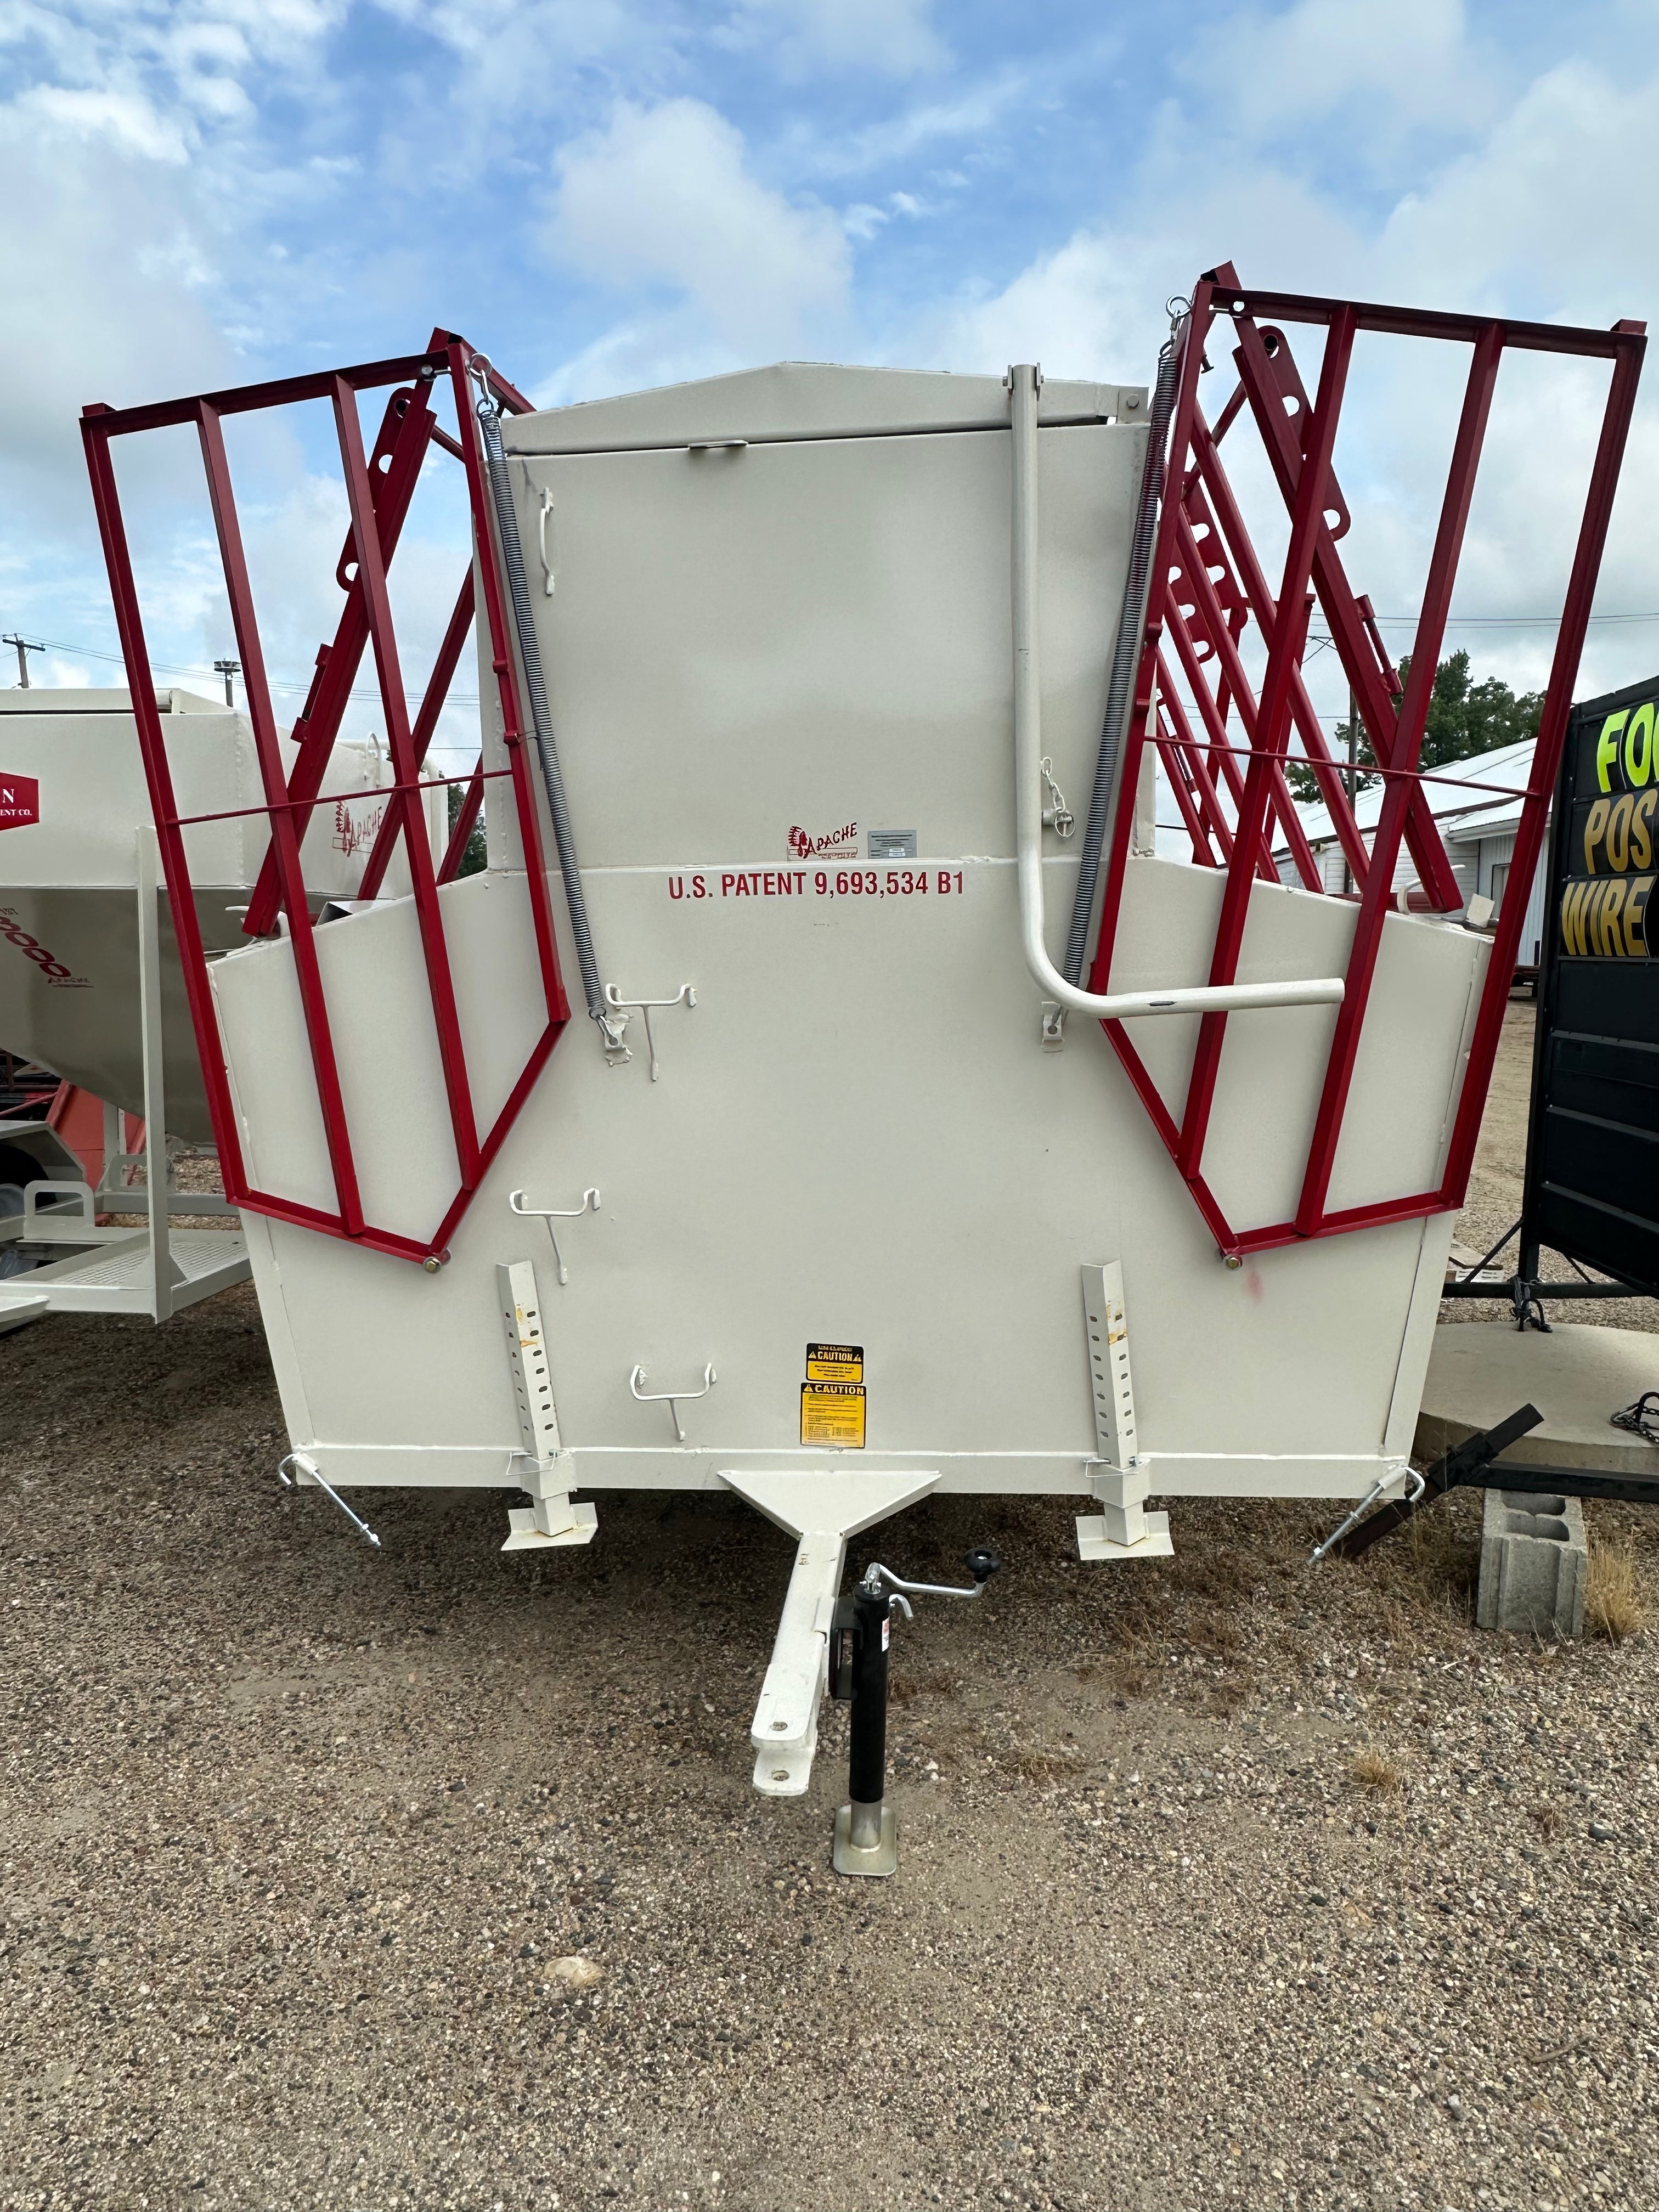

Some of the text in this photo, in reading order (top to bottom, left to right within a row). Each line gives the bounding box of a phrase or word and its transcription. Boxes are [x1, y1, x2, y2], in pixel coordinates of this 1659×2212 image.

[1596, 702, 1659, 793] FO
[803, 822, 858, 859] APACHE
[668, 871, 962, 900] U.S. PATENT 9,693,534 B1
[1561, 875, 1656, 957] WIRE
[817, 1351, 853, 1361] CAUTION
[815, 1385, 864, 1395] CAUTION
